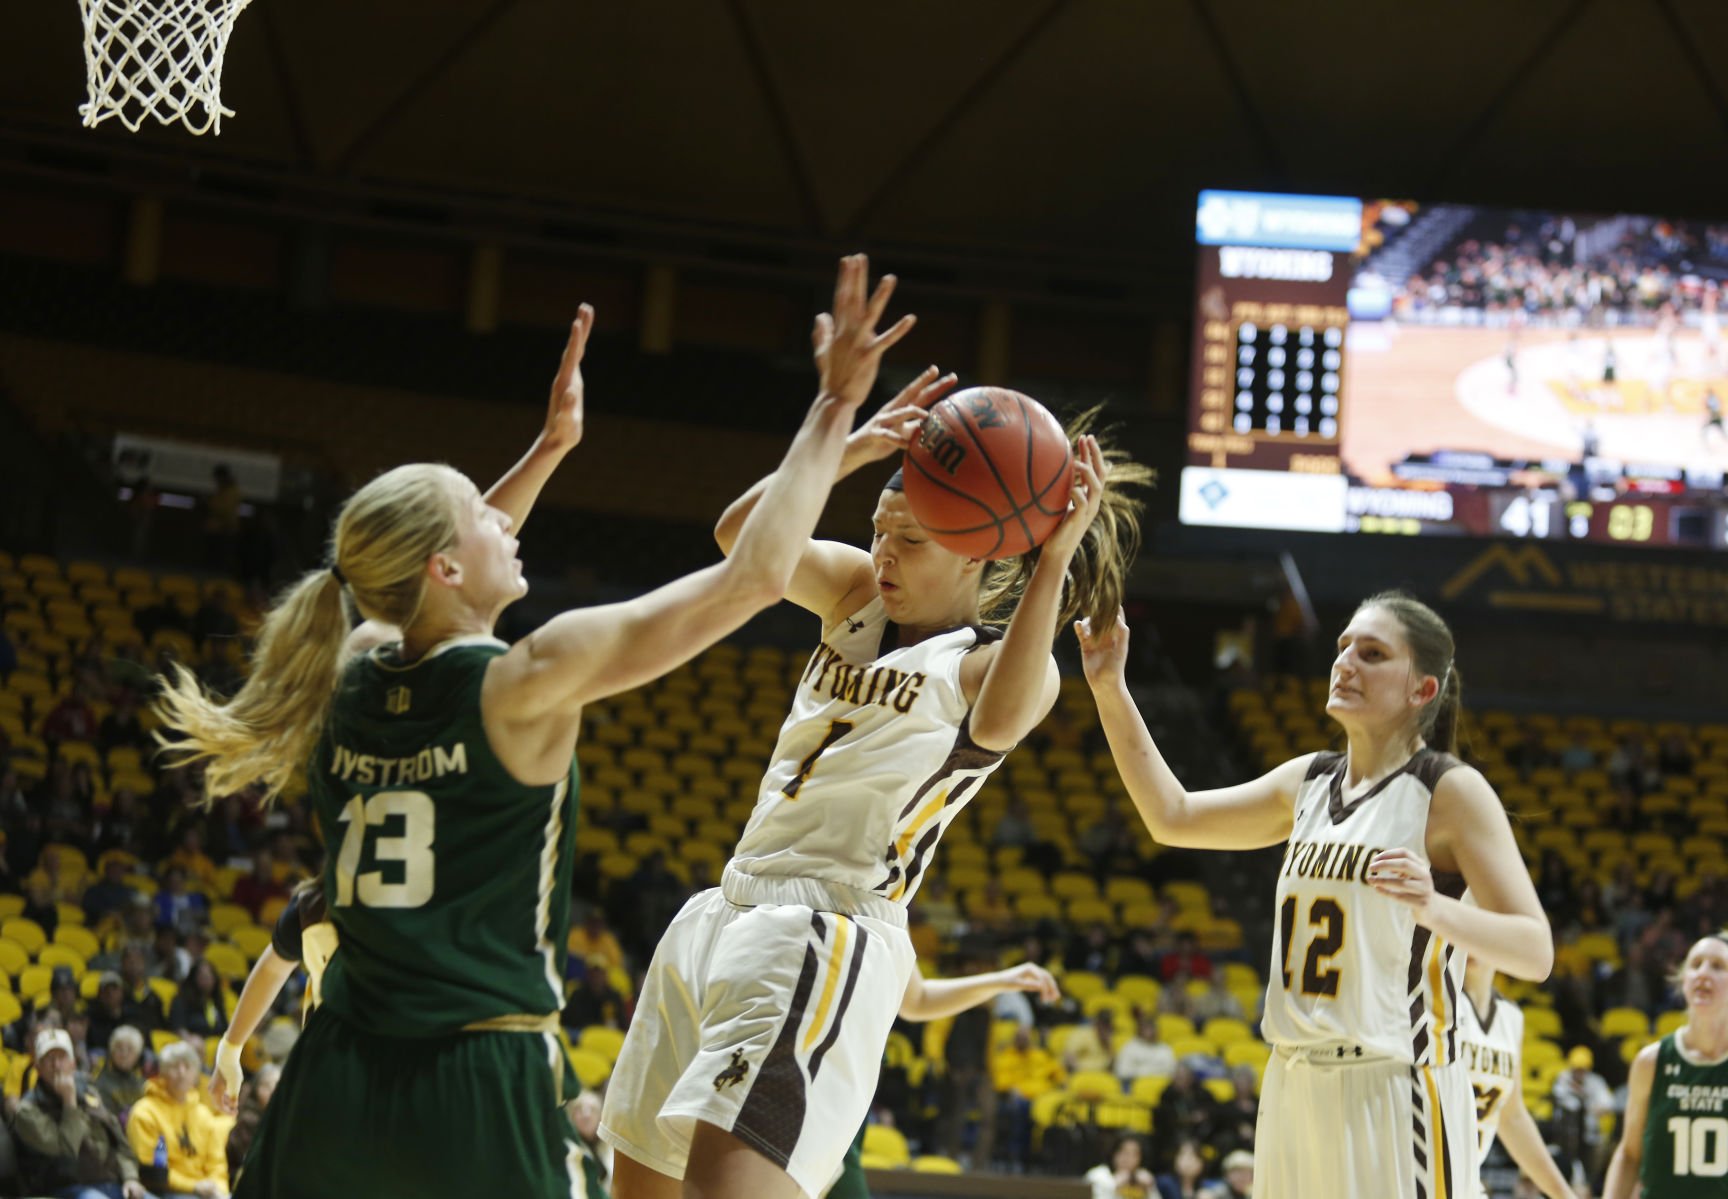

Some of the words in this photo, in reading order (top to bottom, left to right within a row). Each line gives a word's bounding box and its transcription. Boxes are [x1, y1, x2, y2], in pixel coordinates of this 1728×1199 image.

[1501, 497, 1549, 537] 41
[335, 791, 435, 908] 13
[1283, 842, 1385, 884] YOMING
[1281, 894, 1346, 999] 12
[1680, 1098, 1723, 1112] STATE
[1668, 1116, 1728, 1176] 10
